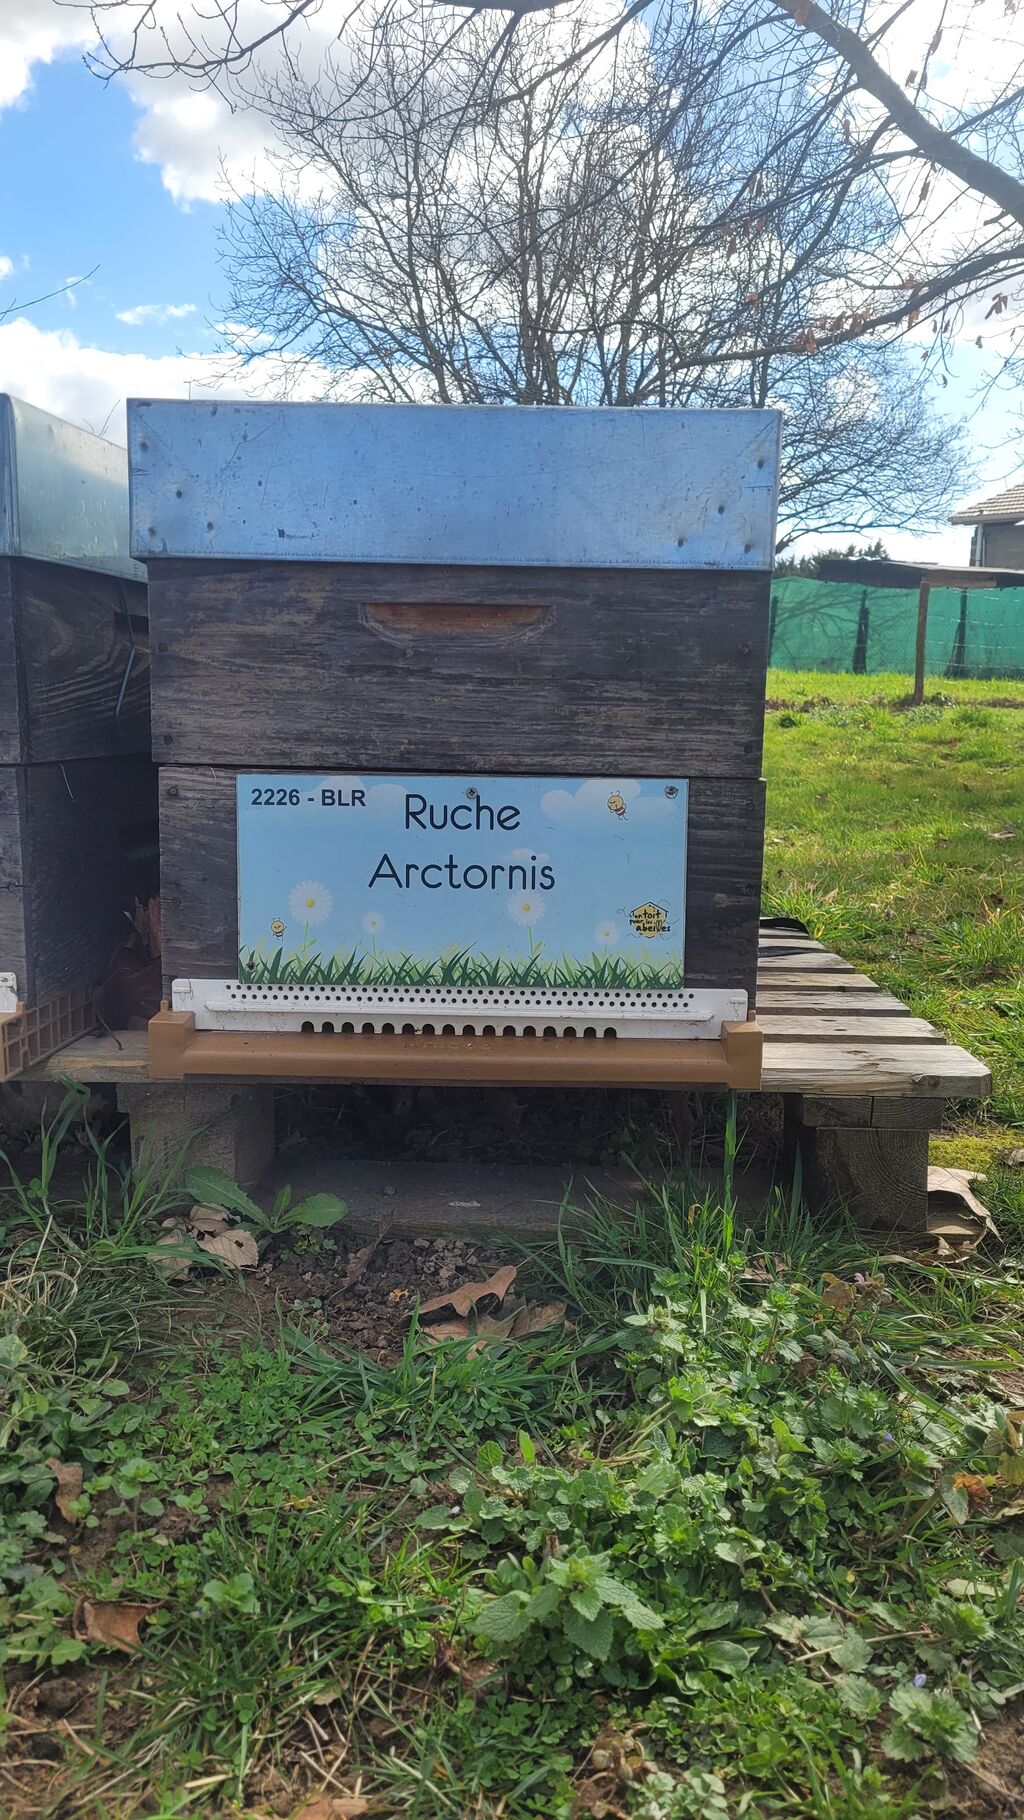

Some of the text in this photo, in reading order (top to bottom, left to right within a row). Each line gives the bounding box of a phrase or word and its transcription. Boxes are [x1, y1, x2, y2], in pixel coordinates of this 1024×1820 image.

[250, 788, 300, 806] 2226
[321, 789, 366, 807] BLR
[405, 794, 520, 831] Ruche
[368, 853, 555, 890] Arctornis
[636, 920, 671, 932] abeilles
